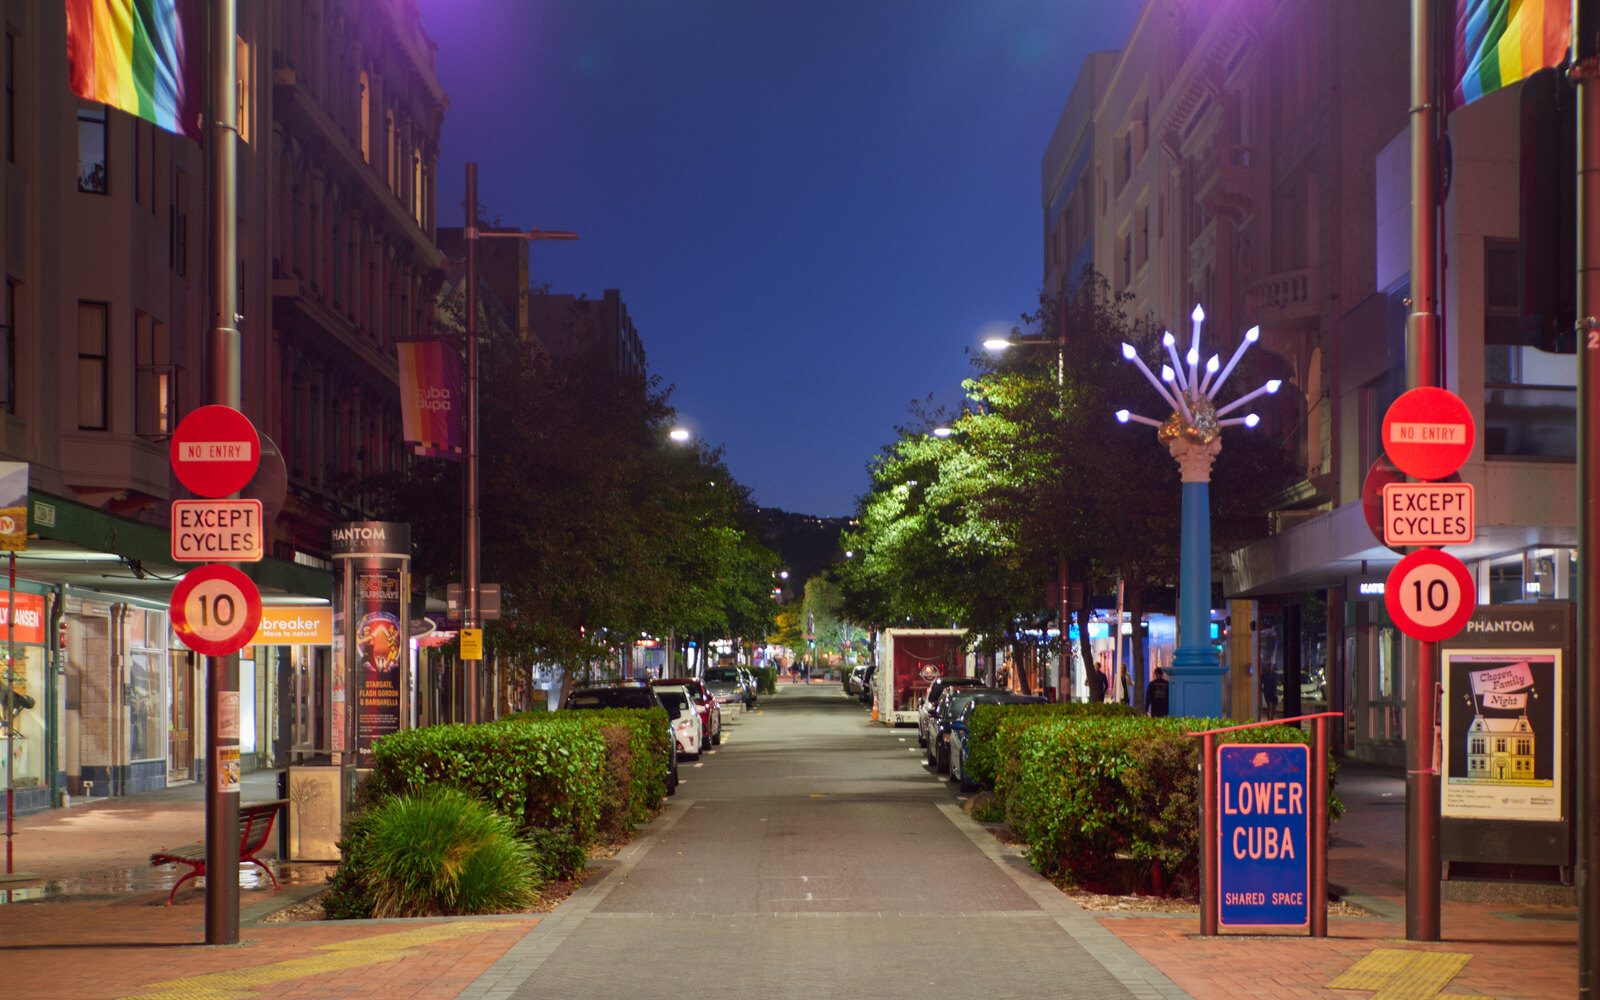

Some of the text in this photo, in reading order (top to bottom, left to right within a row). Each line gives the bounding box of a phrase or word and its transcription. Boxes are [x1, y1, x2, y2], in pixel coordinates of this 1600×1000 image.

[417, 385, 450, 399] cuba
[415, 397, 451, 413] dupa
[1400, 426, 1456, 441] NO ENTRY
[188, 445, 241, 458] NO ENTRY
[1393, 493, 1465, 511] EXCEPT
[181, 509, 253, 527] EXCEPT
[1393, 516, 1466, 535] CYCLES
[180, 533, 254, 551] CYCLES
[1413, 579, 1449, 612] 10
[14, 608, 39, 627] ANSEN
[198, 593, 235, 627] 10
[258, 616, 320, 630] breaker
[1466, 620, 1535, 632] PHANTOM
[1480, 670, 1512, 682] Chosen
[1493, 675, 1524, 690] Family
[1490, 695, 1518, 708] Night
[1225, 781, 1303, 815] LOWER
[1233, 826, 1295, 860] CUBA
[1225, 892, 1303, 905] SHARED SPACE
